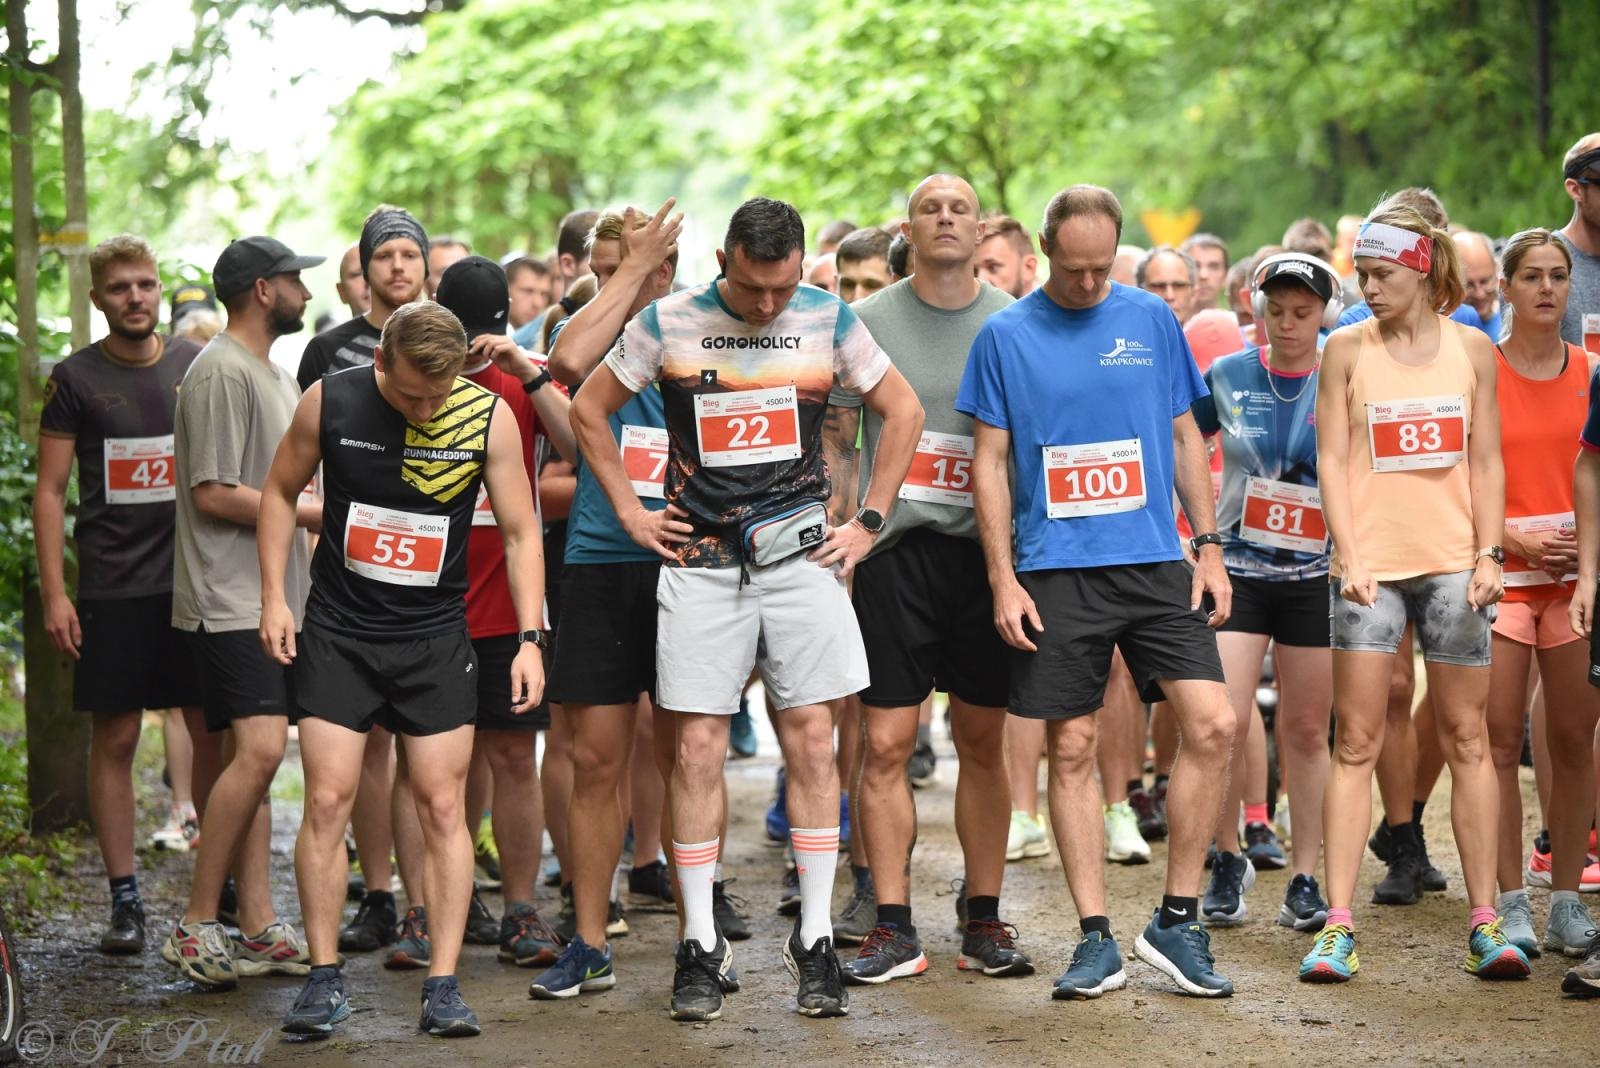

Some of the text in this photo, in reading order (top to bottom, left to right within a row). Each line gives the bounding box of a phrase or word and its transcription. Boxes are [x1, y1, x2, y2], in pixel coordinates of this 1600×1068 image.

[1362, 243, 1397, 255] MARATHON
[1100, 358, 1154, 367] KRAPKOWICE
[702, 400, 720, 408] Bieg
[765, 397, 784, 406] 4500
[784, 396, 792, 404] M
[1375, 406, 1392, 414] Bieg
[1436, 405, 1454, 413] 4500
[726, 415, 771, 448] 22
[1398, 421, 1442, 453] 83
[340, 438, 386, 452] SMMASH
[403, 447, 473, 461] RUNMAGEDDON
[1051, 451, 1068, 459] Bieg
[1111, 450, 1129, 458] 4500
[131, 459, 170, 487] 42
[931, 458, 971, 489] 15
[1064, 466, 1128, 499] 100
[357, 508, 374, 519] Bieg
[1265, 503, 1304, 535] 81
[418, 524, 436, 533] 4500
[371, 533, 417, 567] 55
